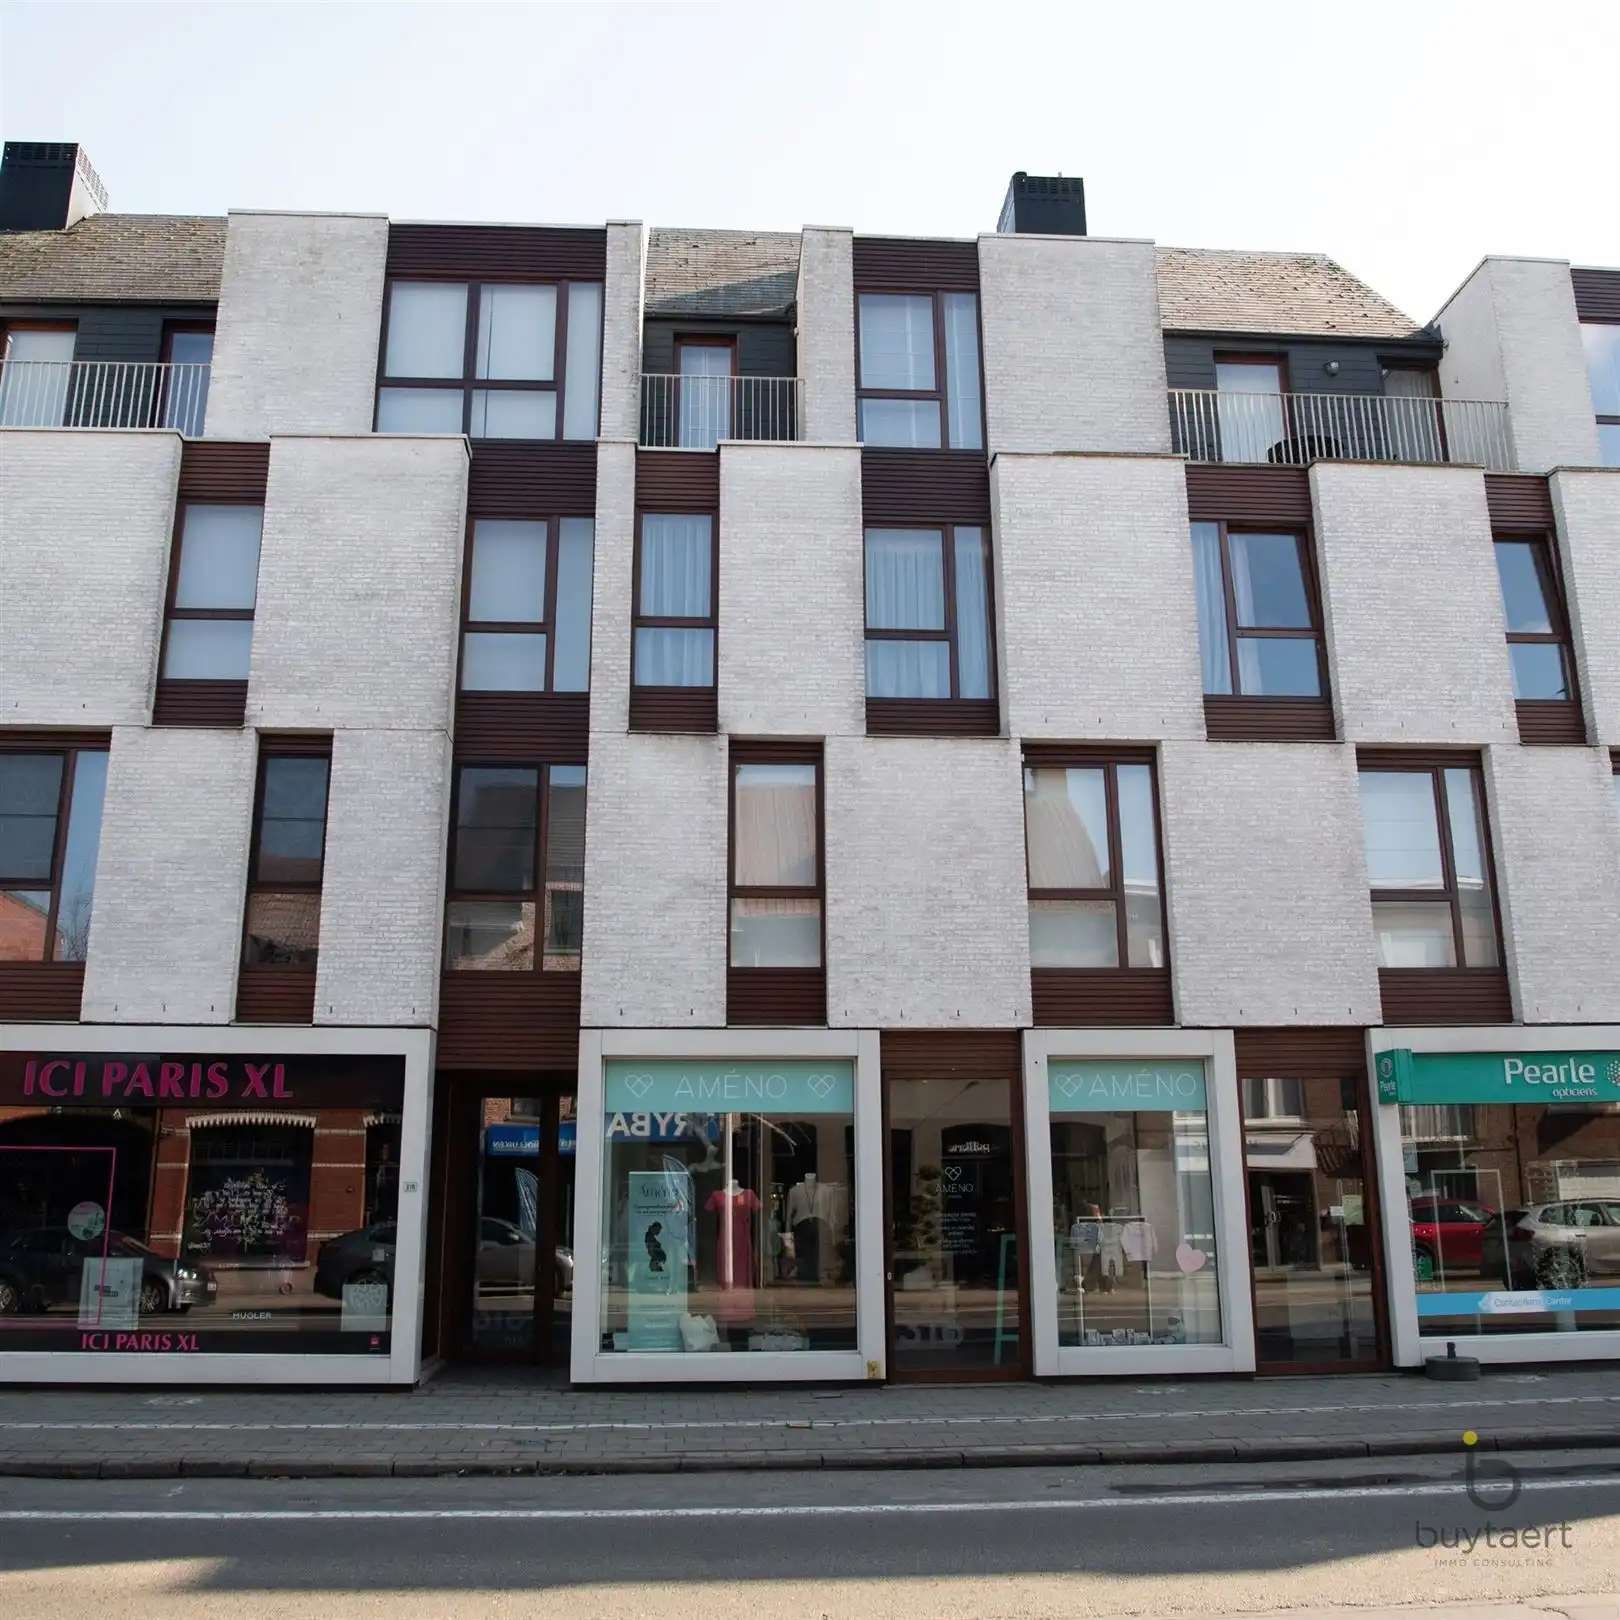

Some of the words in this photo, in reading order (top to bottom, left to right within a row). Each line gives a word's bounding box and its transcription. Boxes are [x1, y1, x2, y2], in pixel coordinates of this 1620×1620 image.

[23, 1060, 87, 1096] ICI
[102, 1062, 229, 1098] PARIS
[241, 1063, 294, 1098] XL
[674, 1069, 788, 1099] AMÉNO
[1088, 1068, 1197, 1098] AMÉNO
[1503, 1057, 1596, 1084] Pearle
[1552, 1087, 1598, 1098] opticiens
[232, 1311, 273, 1320] MUGLER
[81, 1334, 109, 1349] ICI
[115, 1334, 171, 1350] PARIS
[176, 1335, 200, 1350] XL
